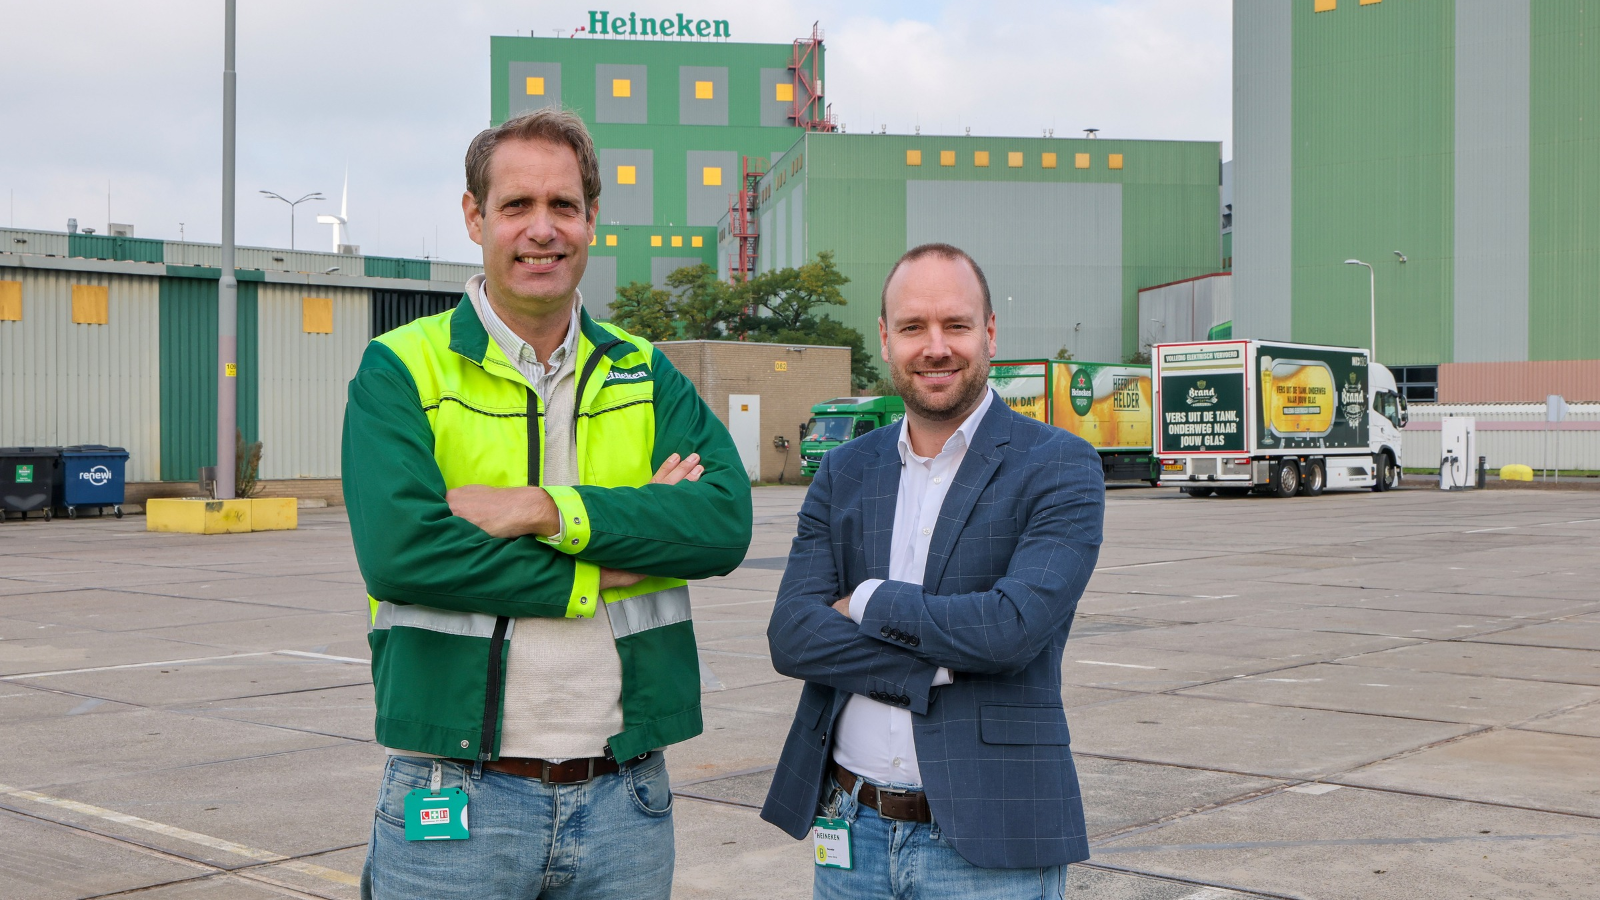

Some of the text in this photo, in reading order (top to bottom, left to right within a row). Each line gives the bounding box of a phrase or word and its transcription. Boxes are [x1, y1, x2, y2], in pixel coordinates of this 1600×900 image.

[588, 10, 731, 38] Heineken
[1165, 355, 1186, 363] VOLLEDIG
[1214, 350, 1238, 360] VERVOERD
[1113, 377, 1140, 391] HEERLIJK
[1276, 386, 1285, 394] VERS
[1071, 388, 1092, 397] Heineken
[1189, 387, 1215, 398] Brand
[1341, 388, 1364, 405] Brand
[1020, 396, 1036, 407] DAT
[1113, 392, 1140, 409] HELDER
[1165, 410, 1240, 423] VERS UIT DE TANK,
[1168, 422, 1237, 435] ONDERWEG NAAR
[1180, 435, 1225, 448] JOUW GLAS
[79, 470, 112, 480] renewi
[816, 832, 840, 841] HEINEKEN
